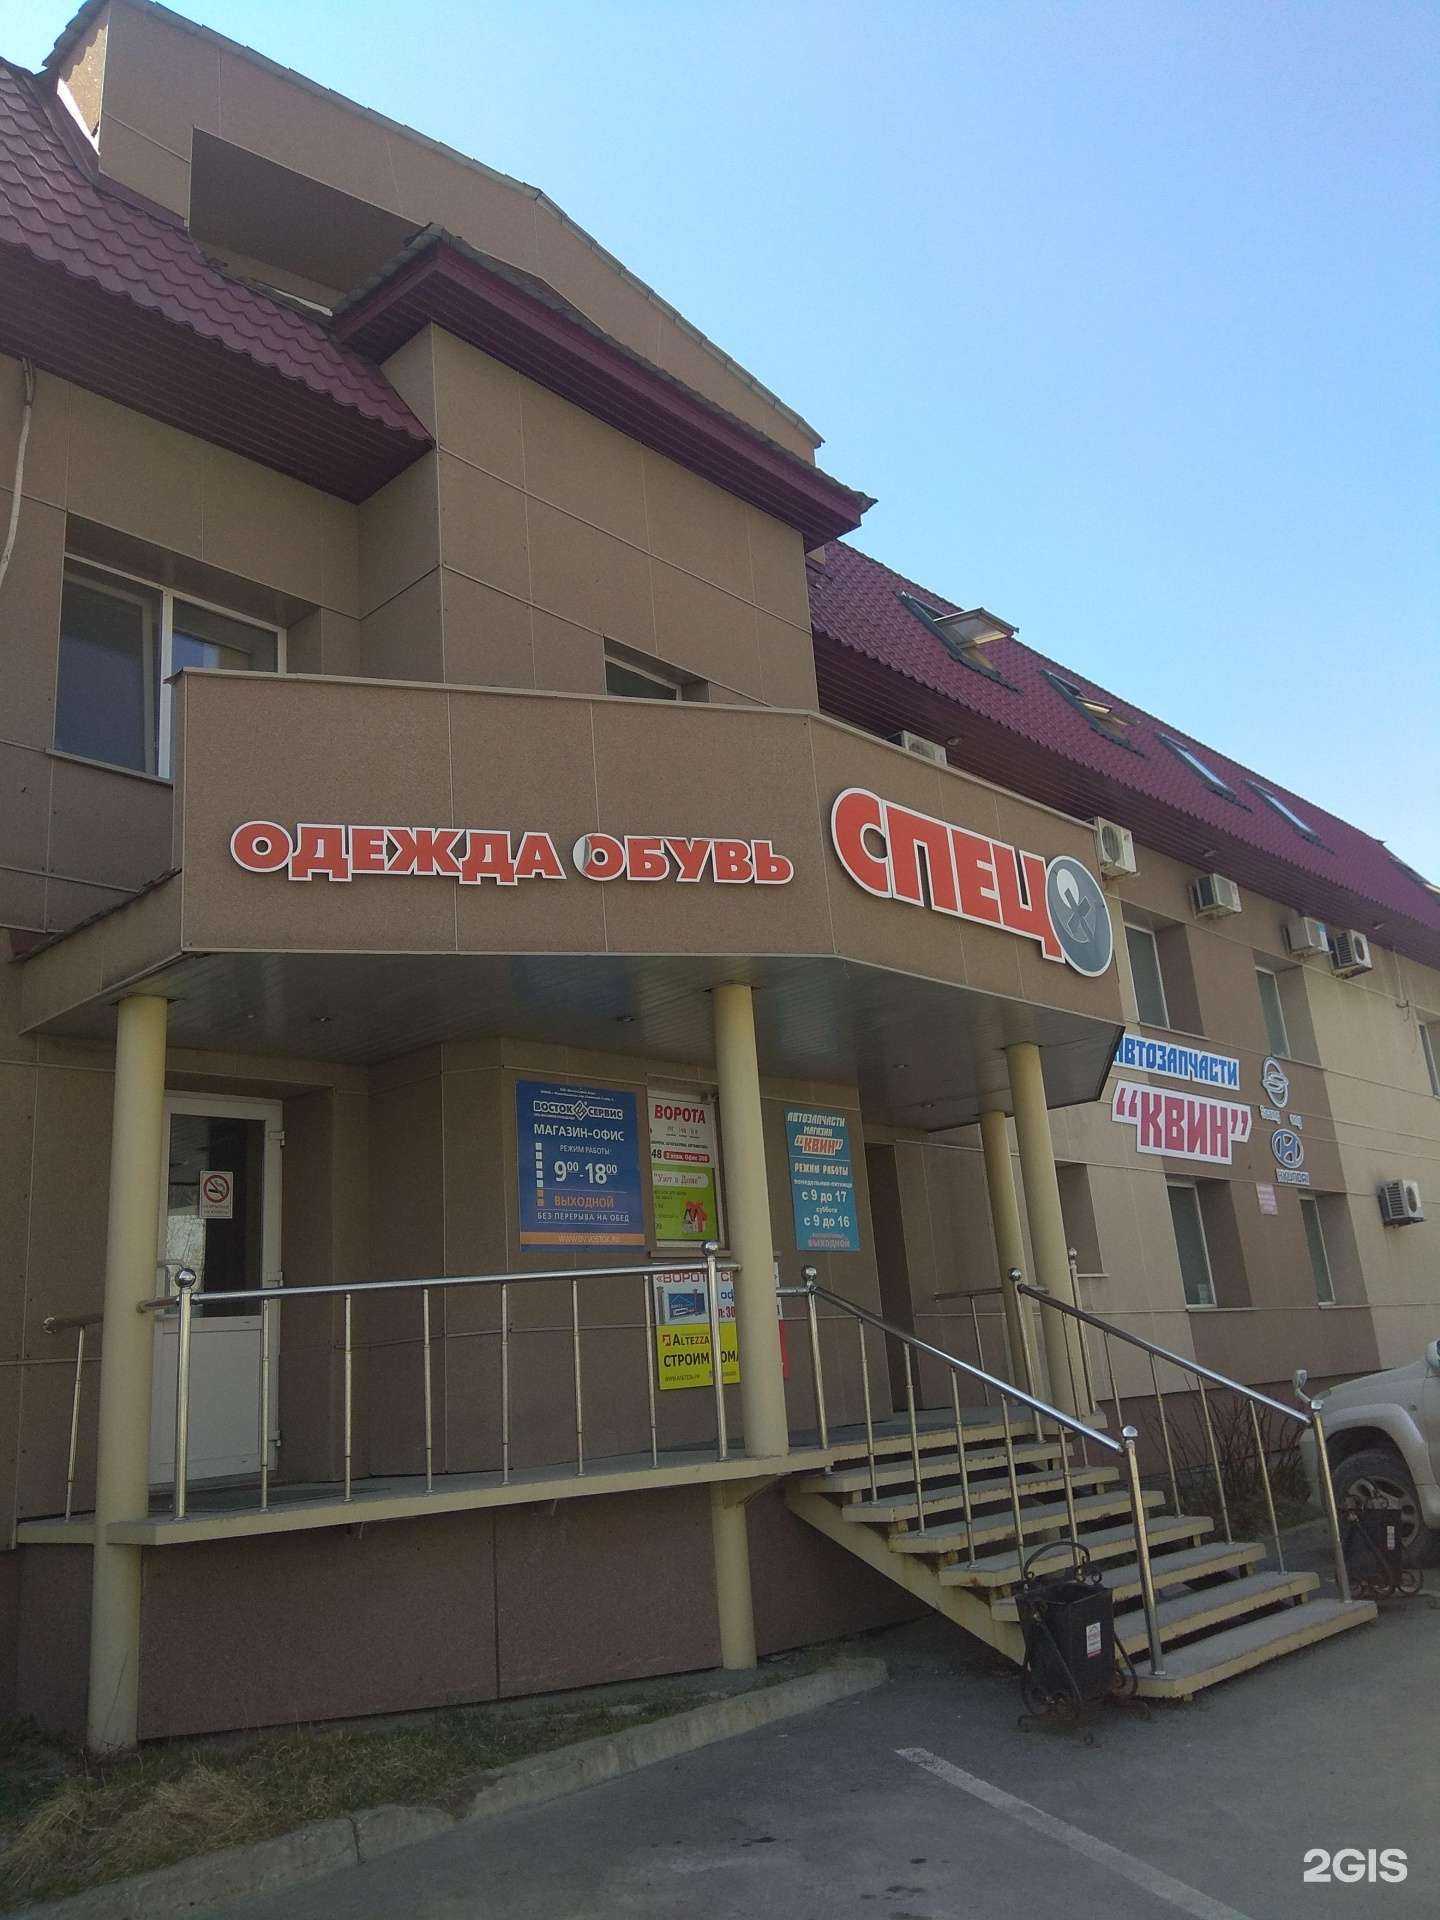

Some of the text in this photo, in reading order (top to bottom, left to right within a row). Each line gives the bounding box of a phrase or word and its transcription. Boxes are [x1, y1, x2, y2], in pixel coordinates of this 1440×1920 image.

[230, 820, 794, 886] ОДЕЖДА ОБУВЬ
[831, 788, 1066, 963] СПЕЦ
[587, 1106, 623, 1120] СЕРВИС
[654, 1104, 706, 1124] ВОРОТА
[534, 1123, 624, 1141] МАГАЗИН-ОФИС
[795, 1163, 849, 1176] РЕЖИМ РАБОТЫ
[554, 1195, 614, 1208] ВЫХОДНОЙ
[811, 1189, 817, 1201] 9
[821, 1192, 832, 1204] до
[835, 1190, 847, 1203] 17
[537, 1212, 552, 1220] БЕЗ
[554, 1212, 594, 1221] ПЕРЕРЫВА
[597, 1214, 607, 1222] НА
[813, 1215, 820, 1227] 9
[823, 1217, 835, 1229] до
[838, 1215, 850, 1228] 16
[663, 1350, 739, 1367] СТРОИМ ОМ
